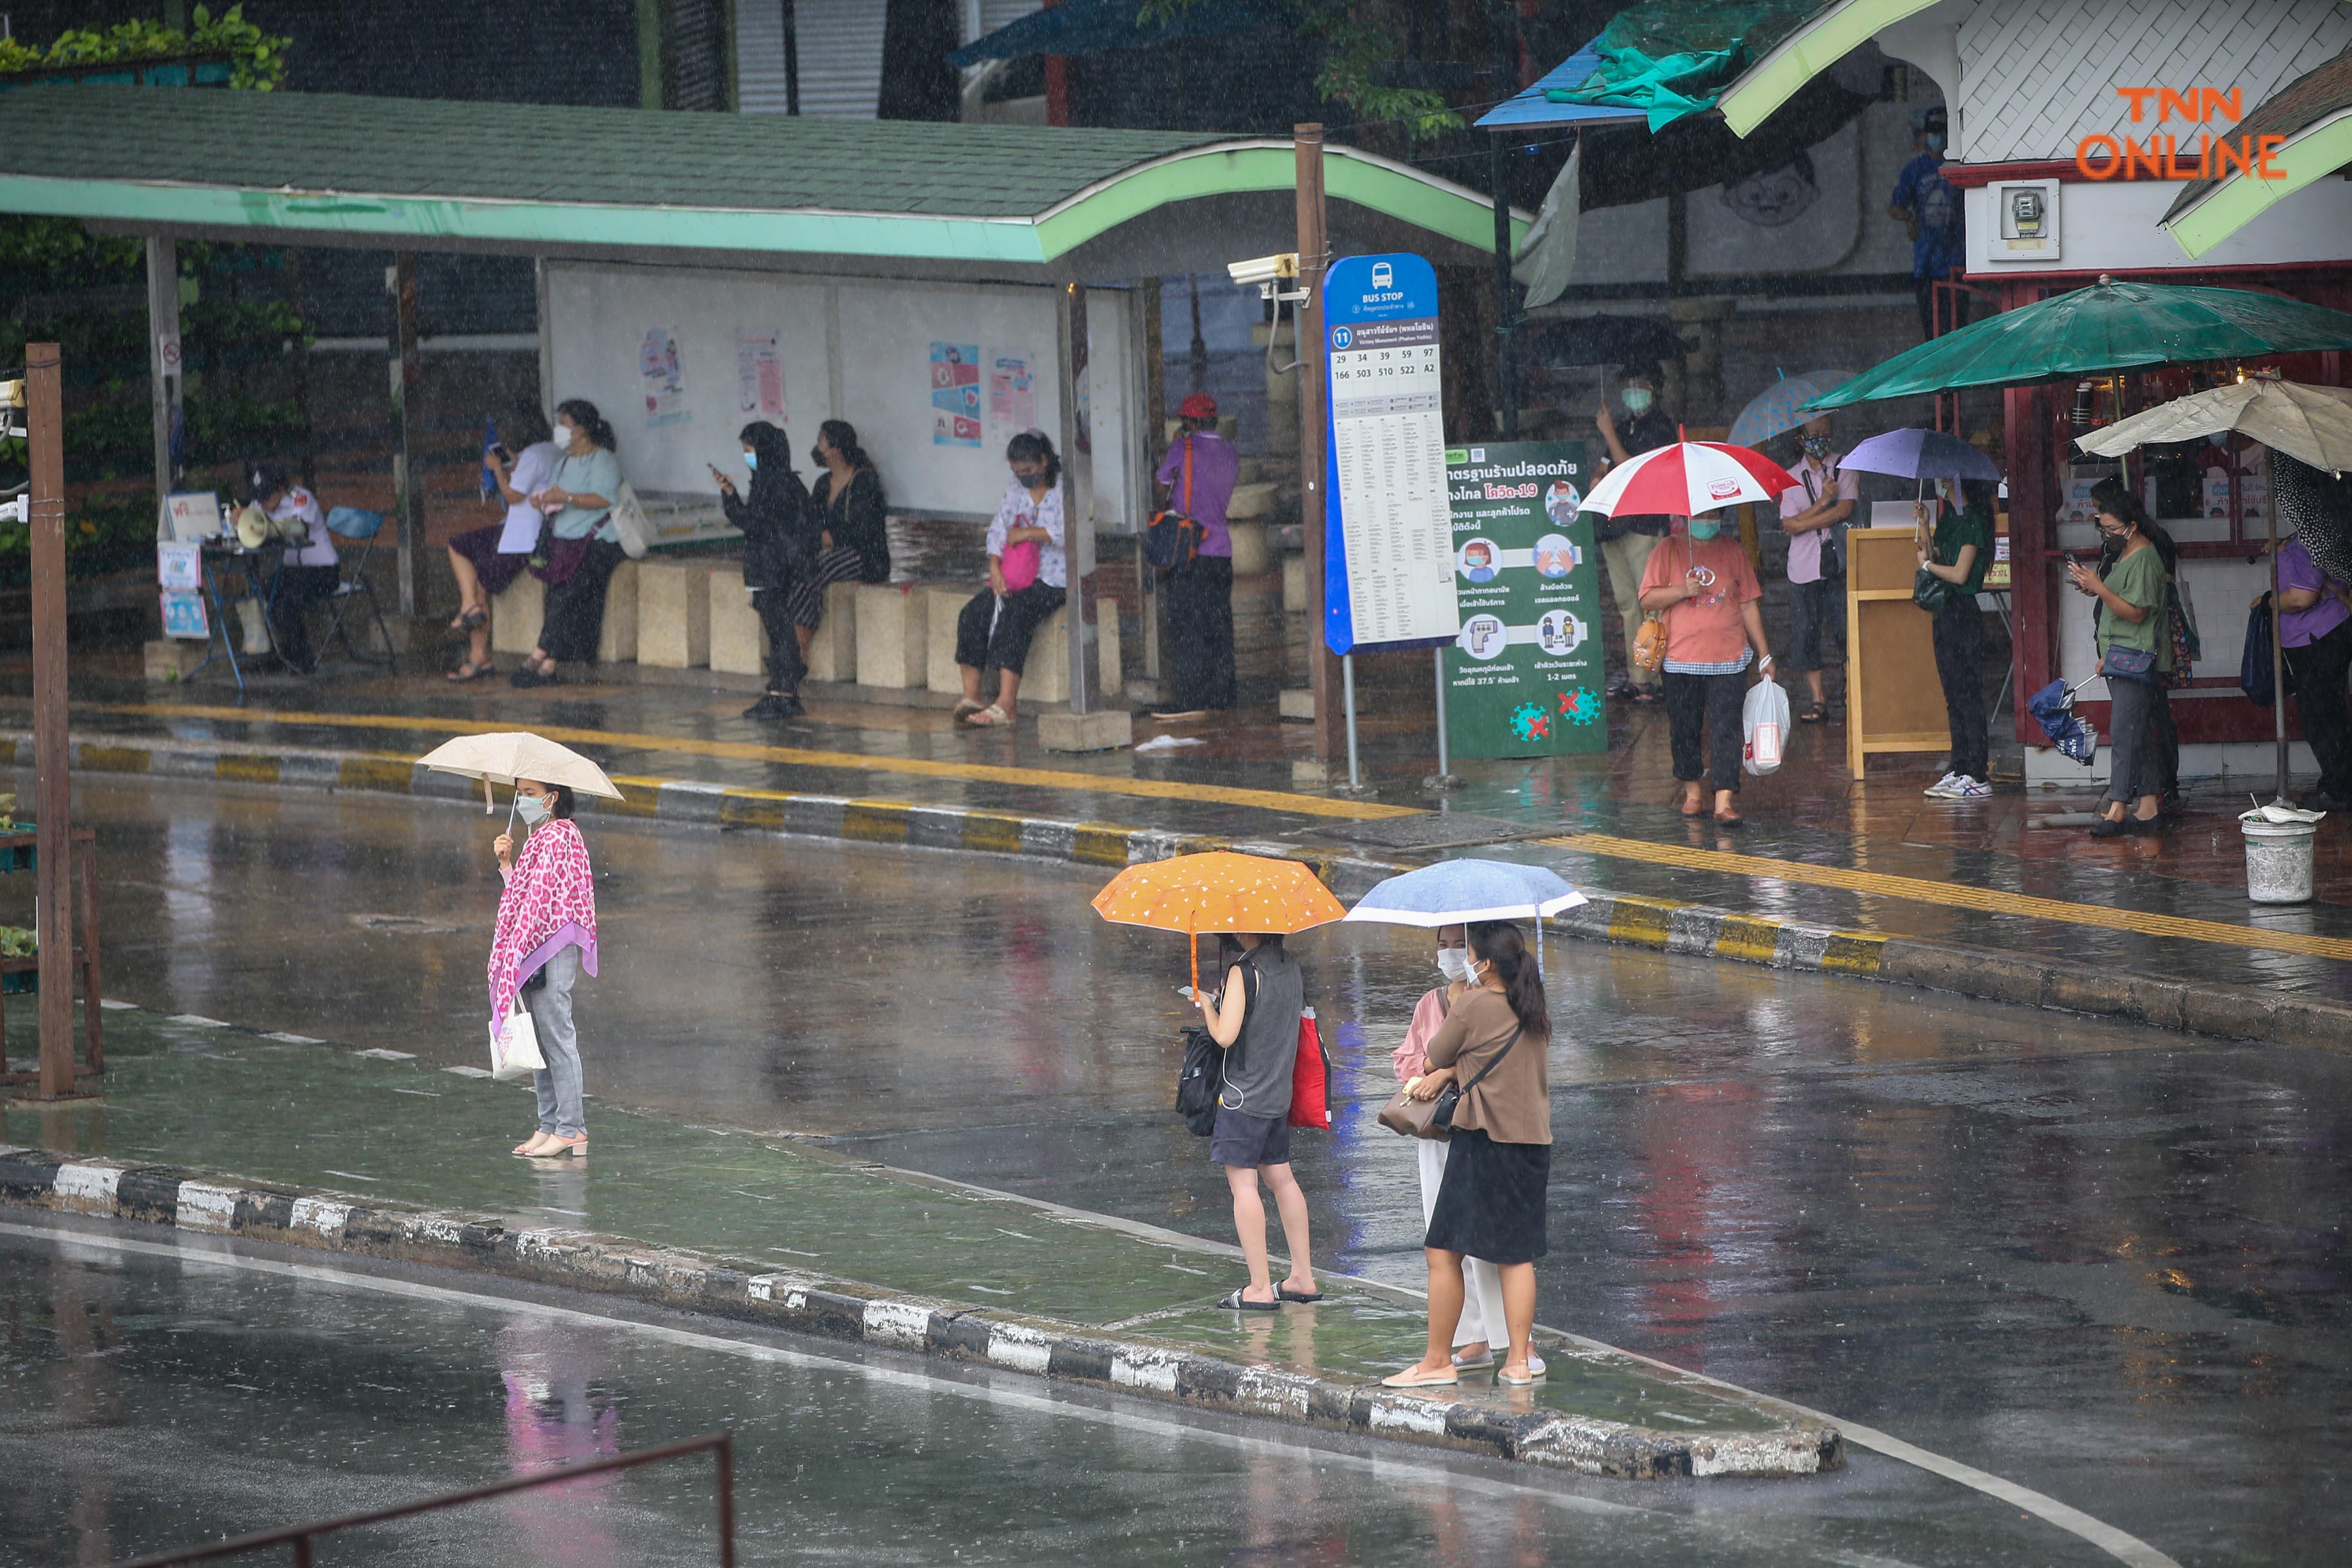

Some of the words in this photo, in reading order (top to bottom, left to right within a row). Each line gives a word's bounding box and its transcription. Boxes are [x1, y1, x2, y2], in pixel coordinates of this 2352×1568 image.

[1362, 293, 1379, 303] BUS
[1381, 291, 1403, 301] STOP
[1336, 332, 1348, 343] 11
[1356, 325, 1397, 338] อนุสาวรีย์ชัยฯ
[1399, 322, 1433, 333] (พหลโยธิน)
[1337, 355, 1346, 364] 29
[1358, 353, 1367, 362] 34
[1380, 351, 1390, 360] 39
[1402, 350, 1411, 359] 59
[1424, 348, 1433, 357] 97
[1335, 371, 1349, 380] 166
[1356, 369, 1371, 378] 503
[1379, 367, 1393, 376] 510
[1400, 366, 1414, 374] 522
[1424, 364, 1434, 372] A2
[1447, 459, 1578, 482] าตรฐานร้านปลอดภัย
[1448, 486, 1482, 500] างไกล
[1484, 483, 1539, 500] โควิด-19
[1476, 505, 1530, 519] และลูกค้าโปรด
